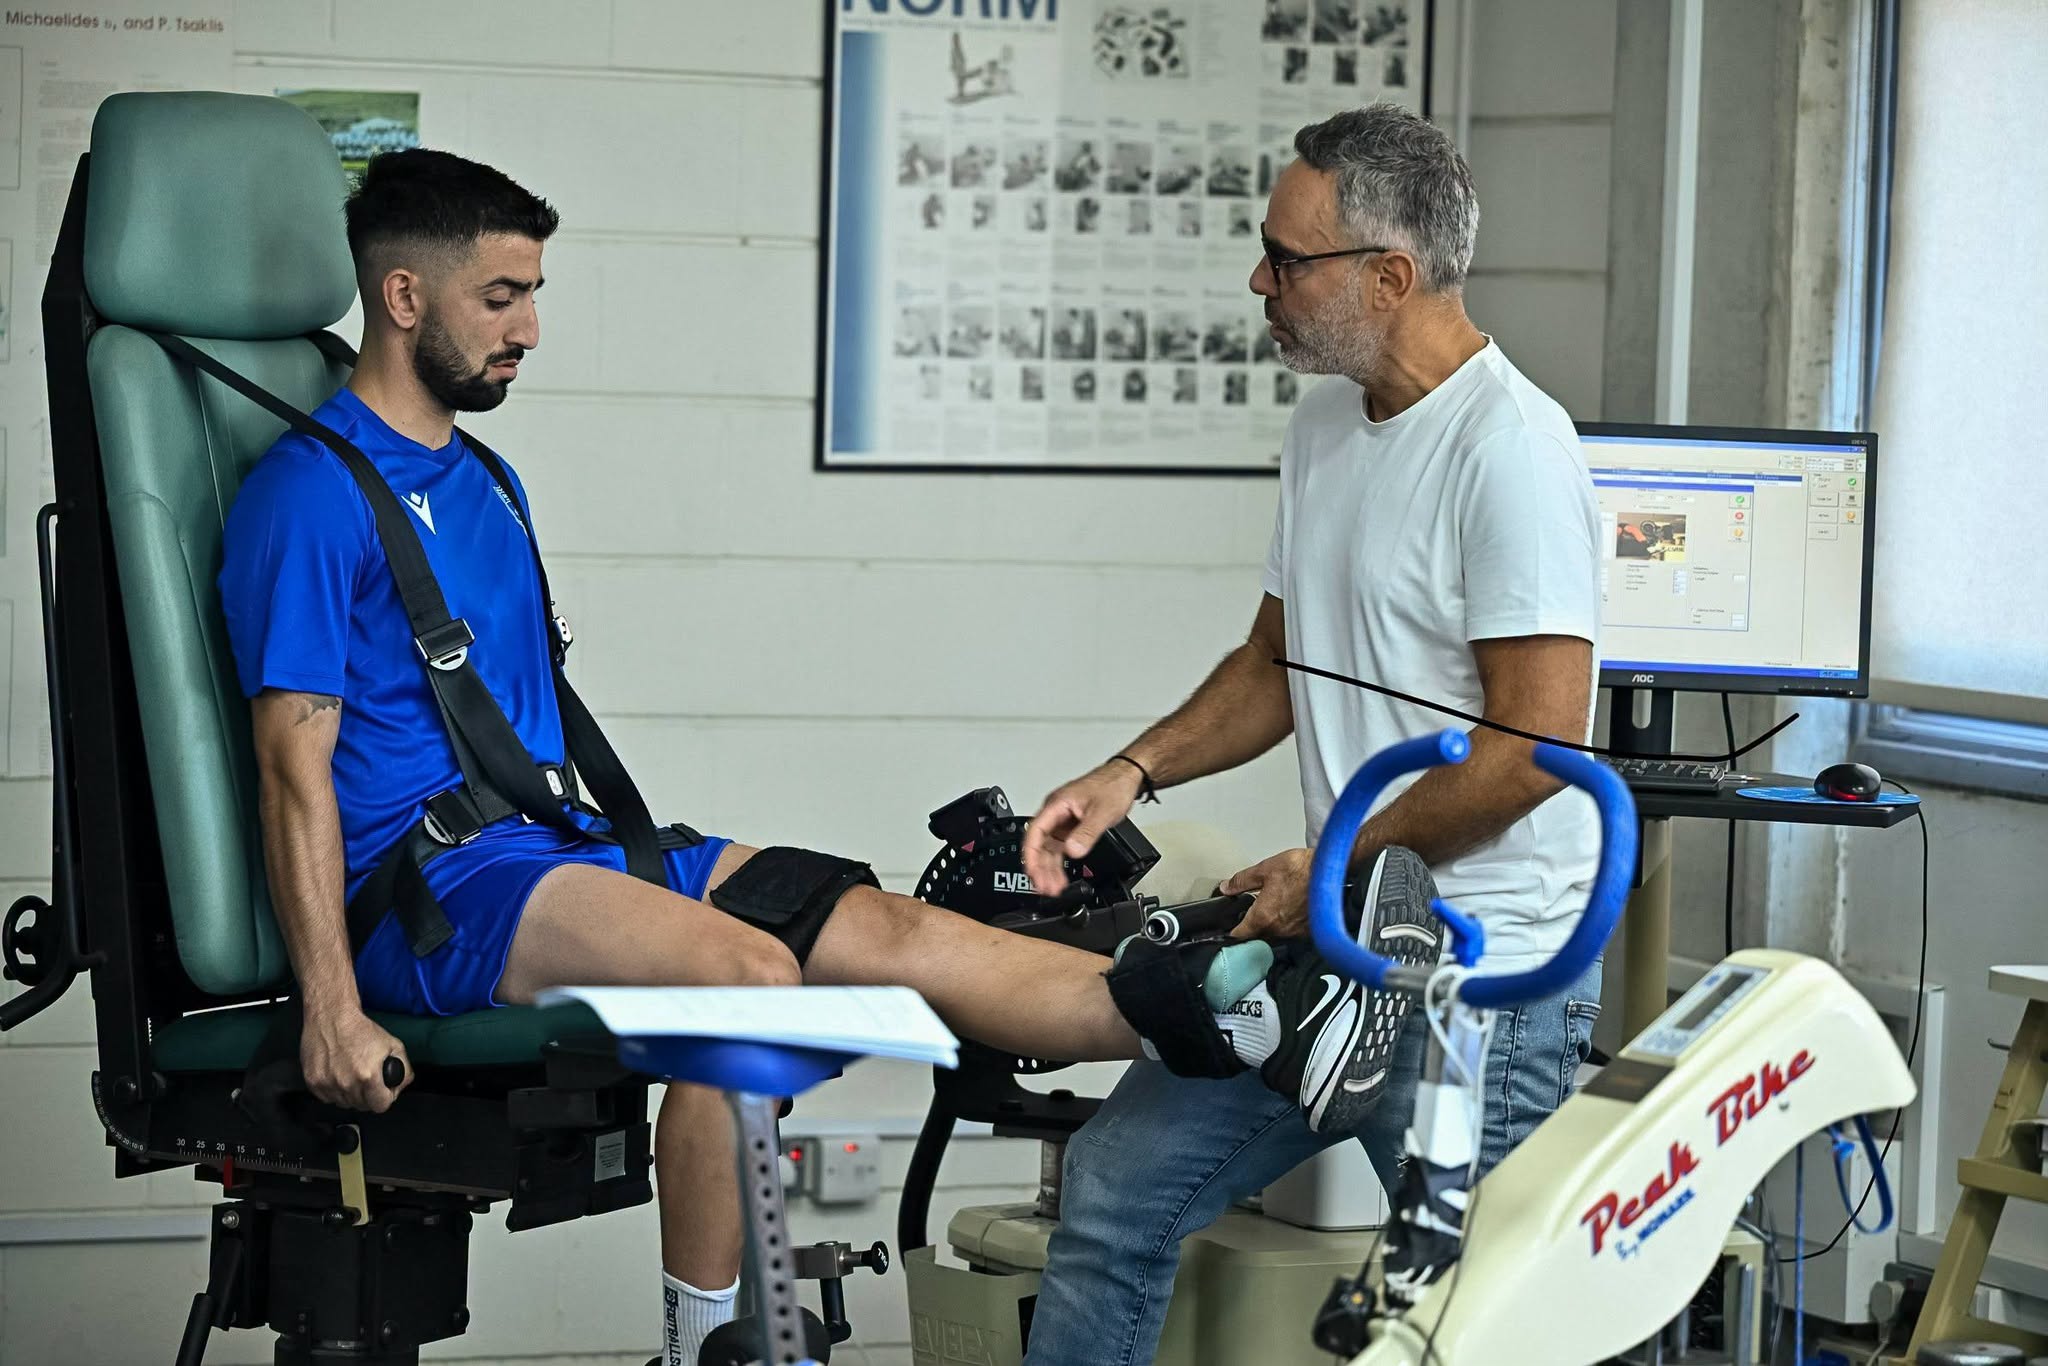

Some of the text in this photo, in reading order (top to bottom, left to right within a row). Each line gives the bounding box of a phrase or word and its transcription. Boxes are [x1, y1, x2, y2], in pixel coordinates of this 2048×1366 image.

[6, 11, 99, 28] Michaelides
[123, 16, 154, 30] and
[176, 17, 224, 32] Tsaklis
[1632, 674, 1654, 683] AOC
[994, 871, 1038, 892] CYB
[1216, 1001, 1263, 1018] OCKS
[1706, 1048, 1816, 1147] Bike
[176, 1137, 266, 1156] 30 25 20 15 10
[1580, 1140, 1700, 1257] Peak
[667, 1306, 682, 1366] FOOTBALLS
